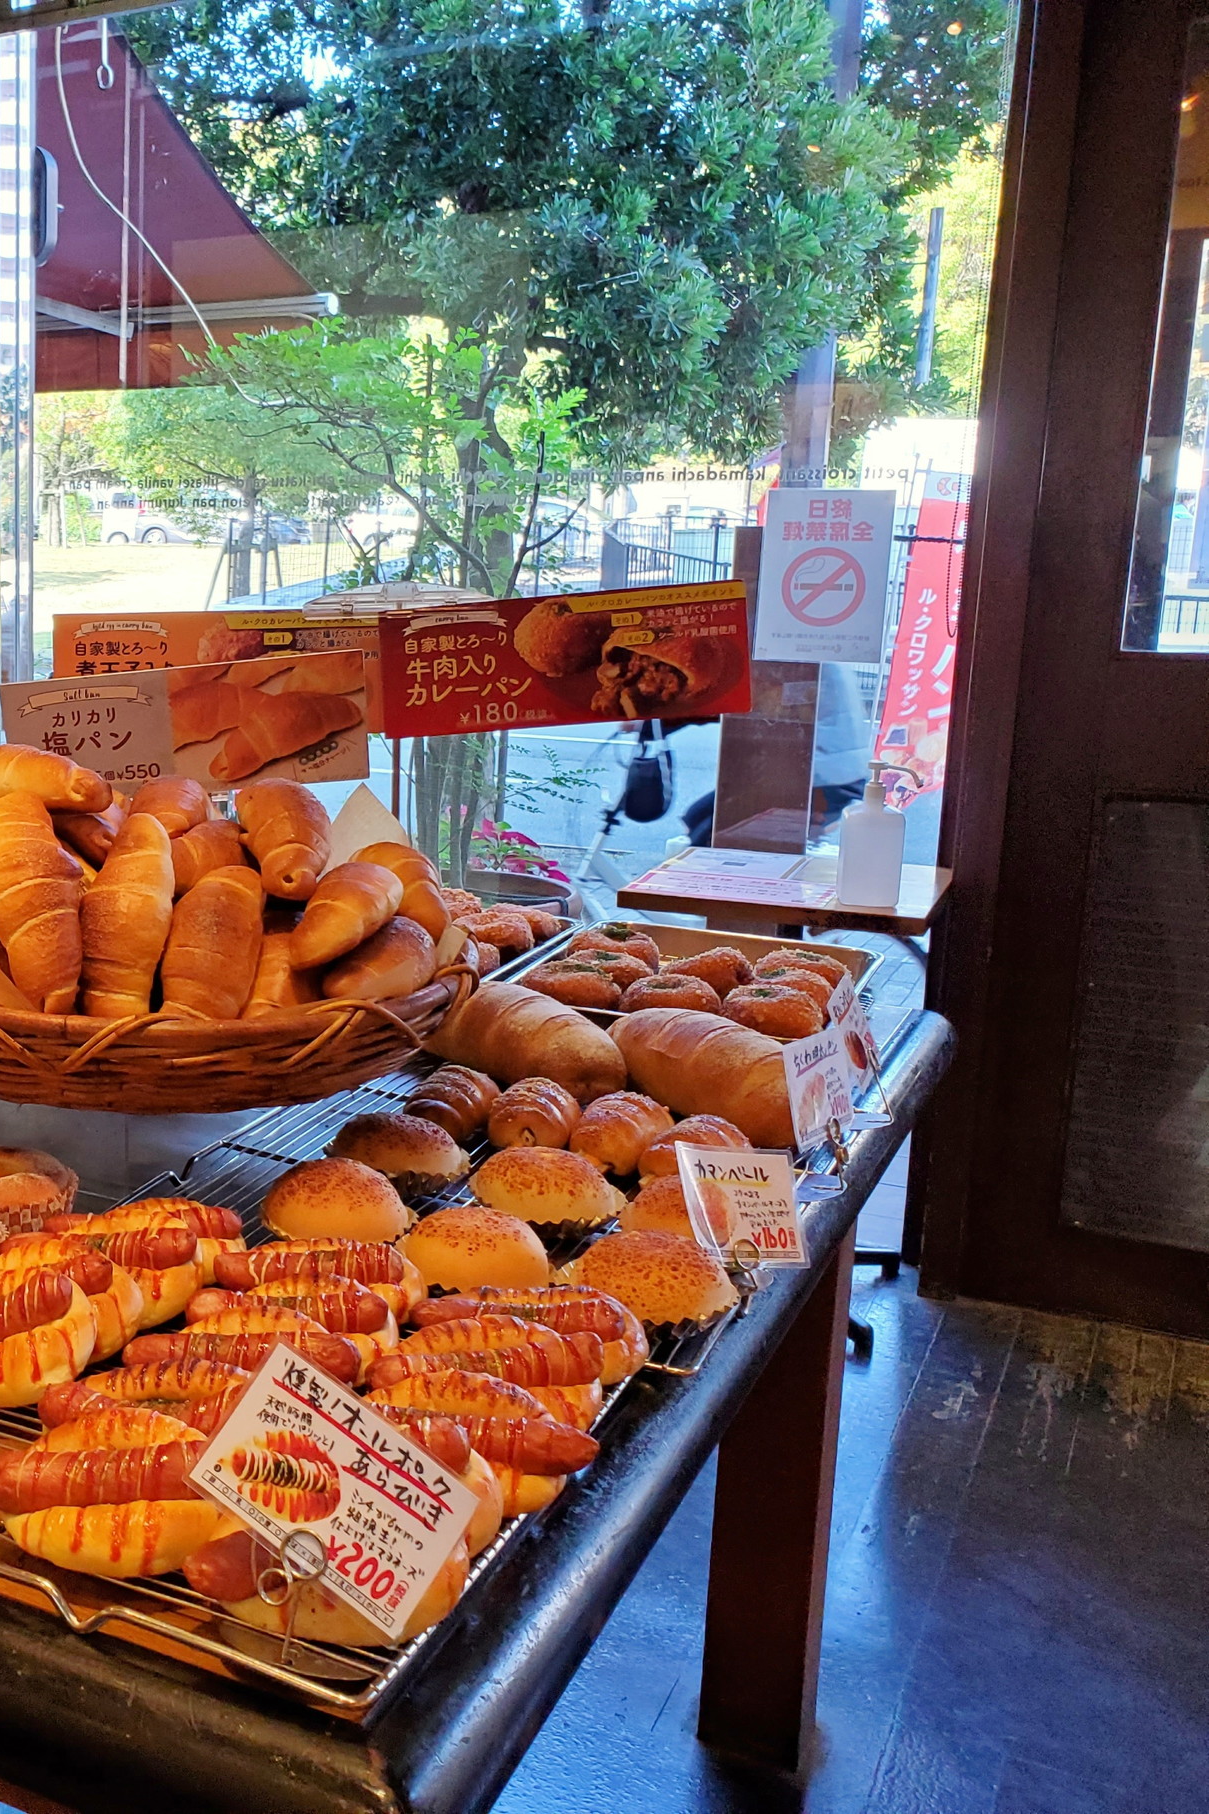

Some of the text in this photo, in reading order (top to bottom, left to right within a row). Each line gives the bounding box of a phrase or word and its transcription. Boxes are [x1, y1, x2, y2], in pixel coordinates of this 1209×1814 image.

[406, 654, 496, 682] 牛肉入り
[405, 677, 532, 708] カレーパン
[51, 707, 117, 728] カリカリ
[41, 730, 132, 756] 塩パン
[694, 1158, 770, 1182] カマンベール
[350, 1448, 445, 1525] あらびき
[326, 1535, 396, 1600] ¥200
